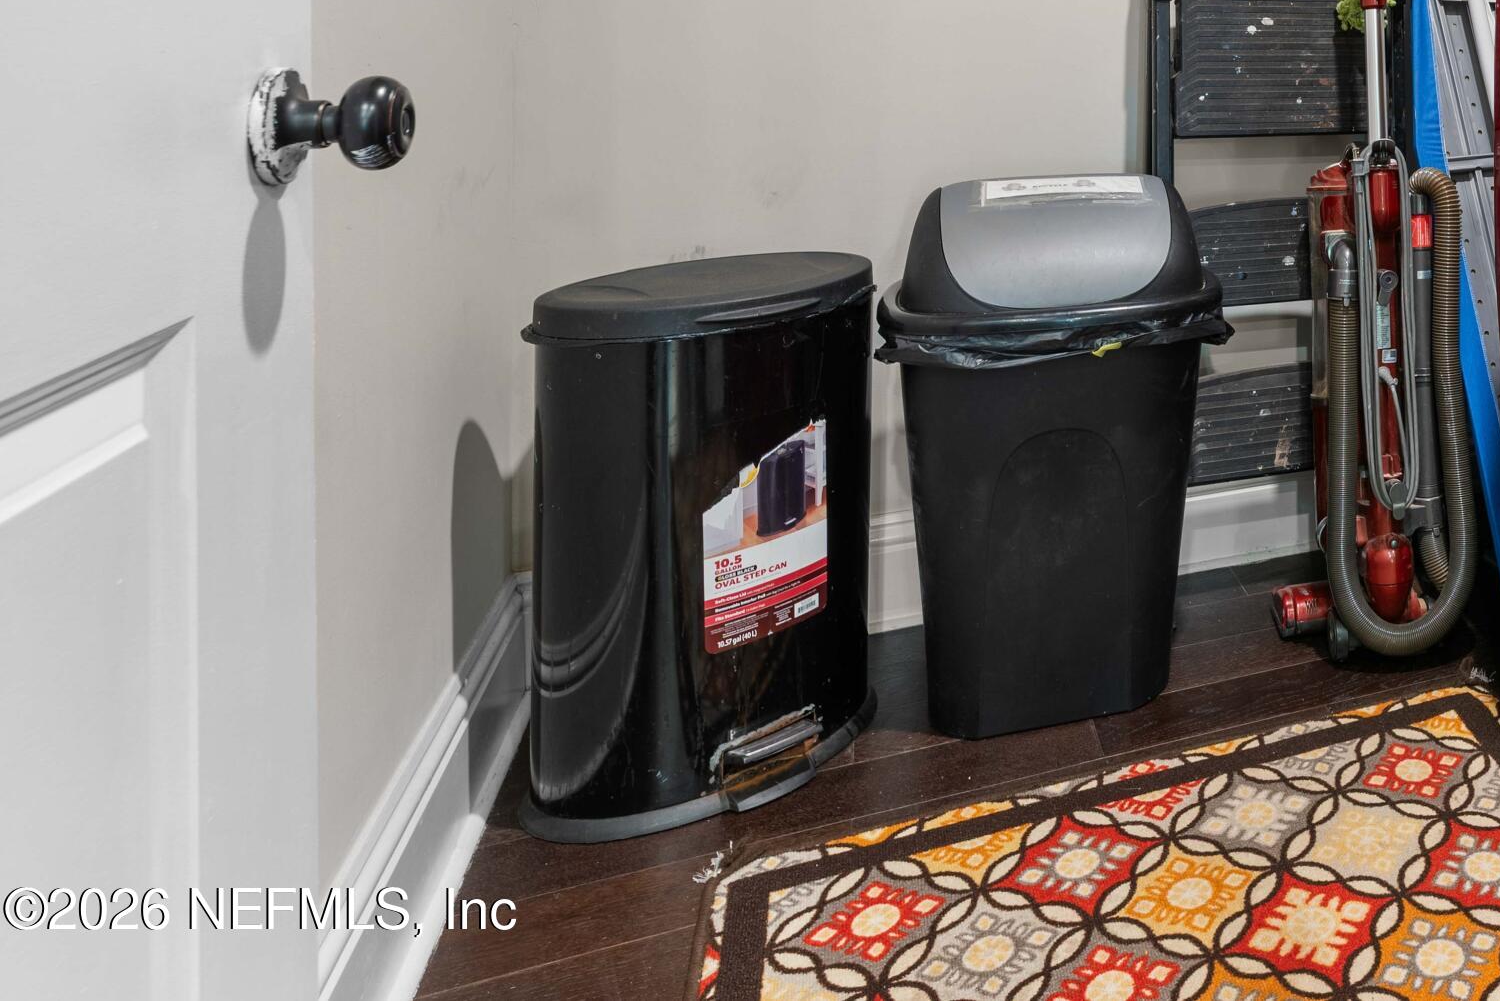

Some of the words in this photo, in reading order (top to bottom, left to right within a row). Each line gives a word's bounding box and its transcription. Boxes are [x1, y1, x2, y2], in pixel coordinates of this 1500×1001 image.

[714, 555, 742, 569] 10.5
[714, 564, 742, 575] GALLON
[715, 578, 741, 590] OVAL
[744, 569, 767, 581] STEP
[768, 561, 787, 574] CAN
[737, 566, 755, 577] BLACK
[717, 638, 733, 648] 10.57
[732, 636, 742, 646] gal
